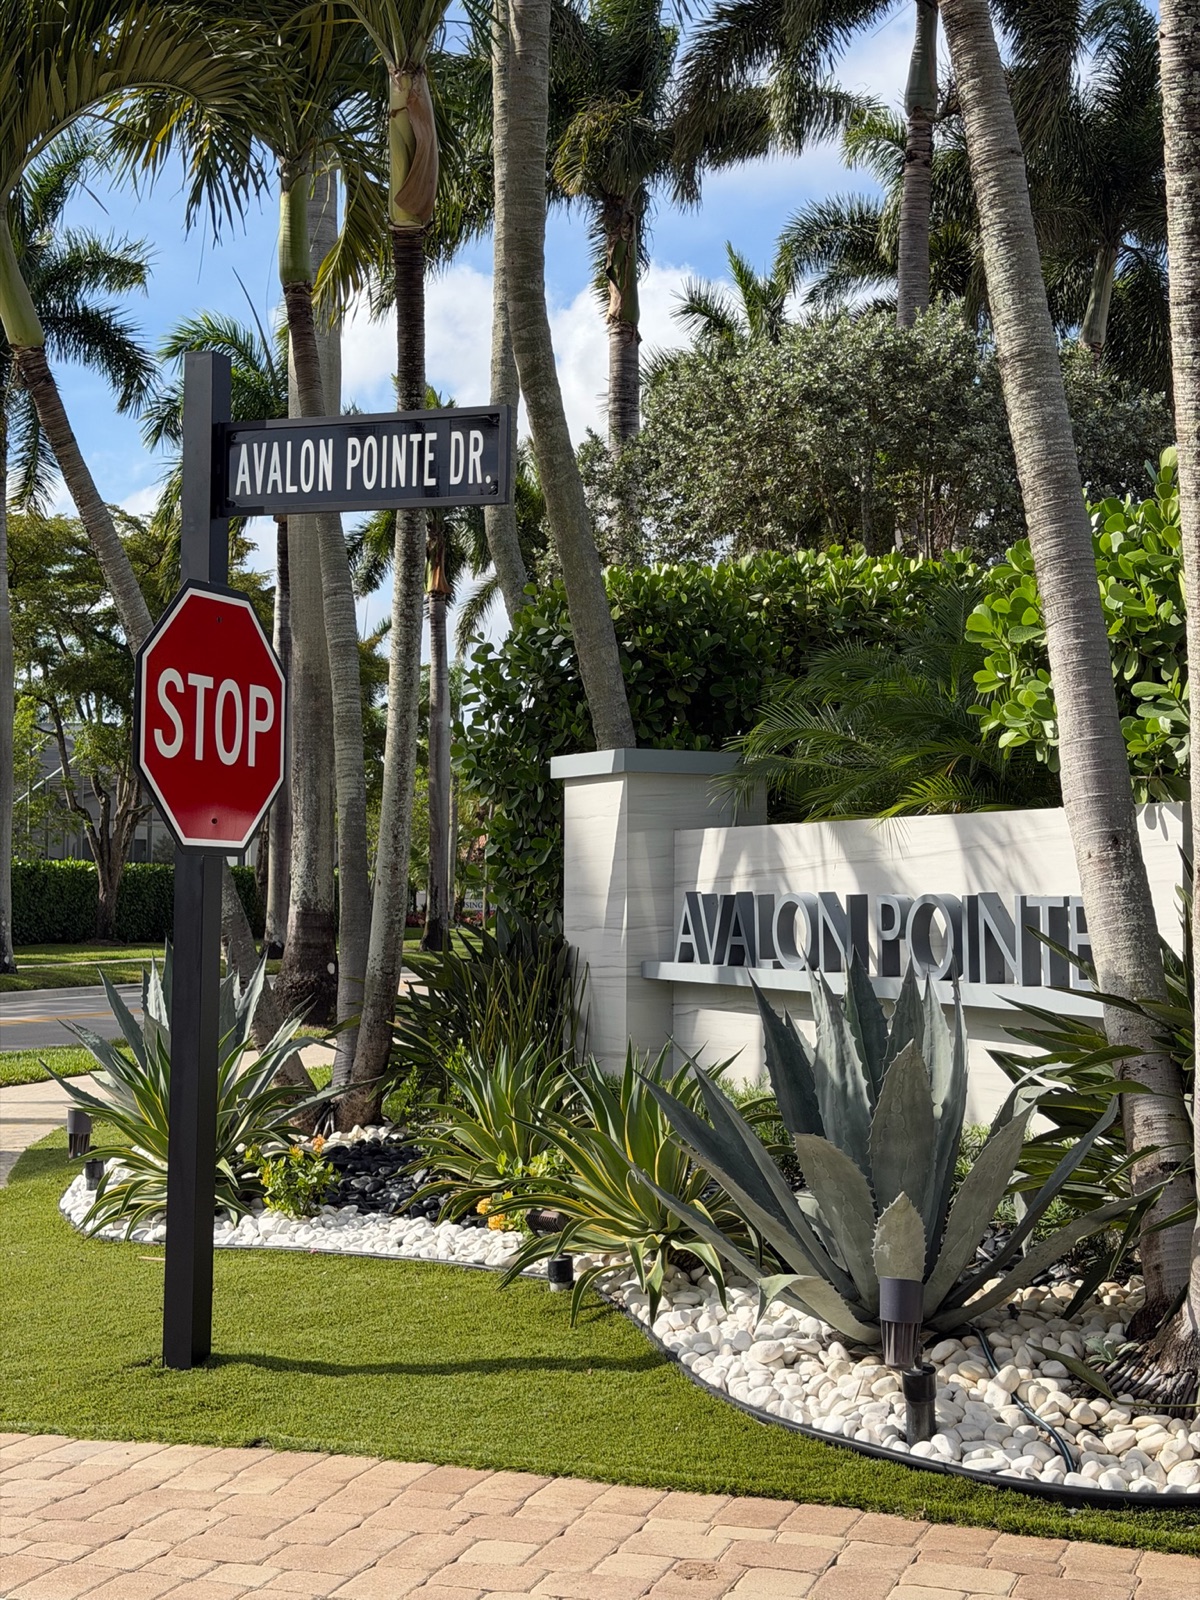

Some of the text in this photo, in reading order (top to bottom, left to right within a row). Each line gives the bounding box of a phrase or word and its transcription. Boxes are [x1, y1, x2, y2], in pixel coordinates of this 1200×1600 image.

[235, 430, 492, 495] AVALON POINTE DR.
[154, 668, 275, 767] STOP
[674, 891, 869, 974] AVALON
